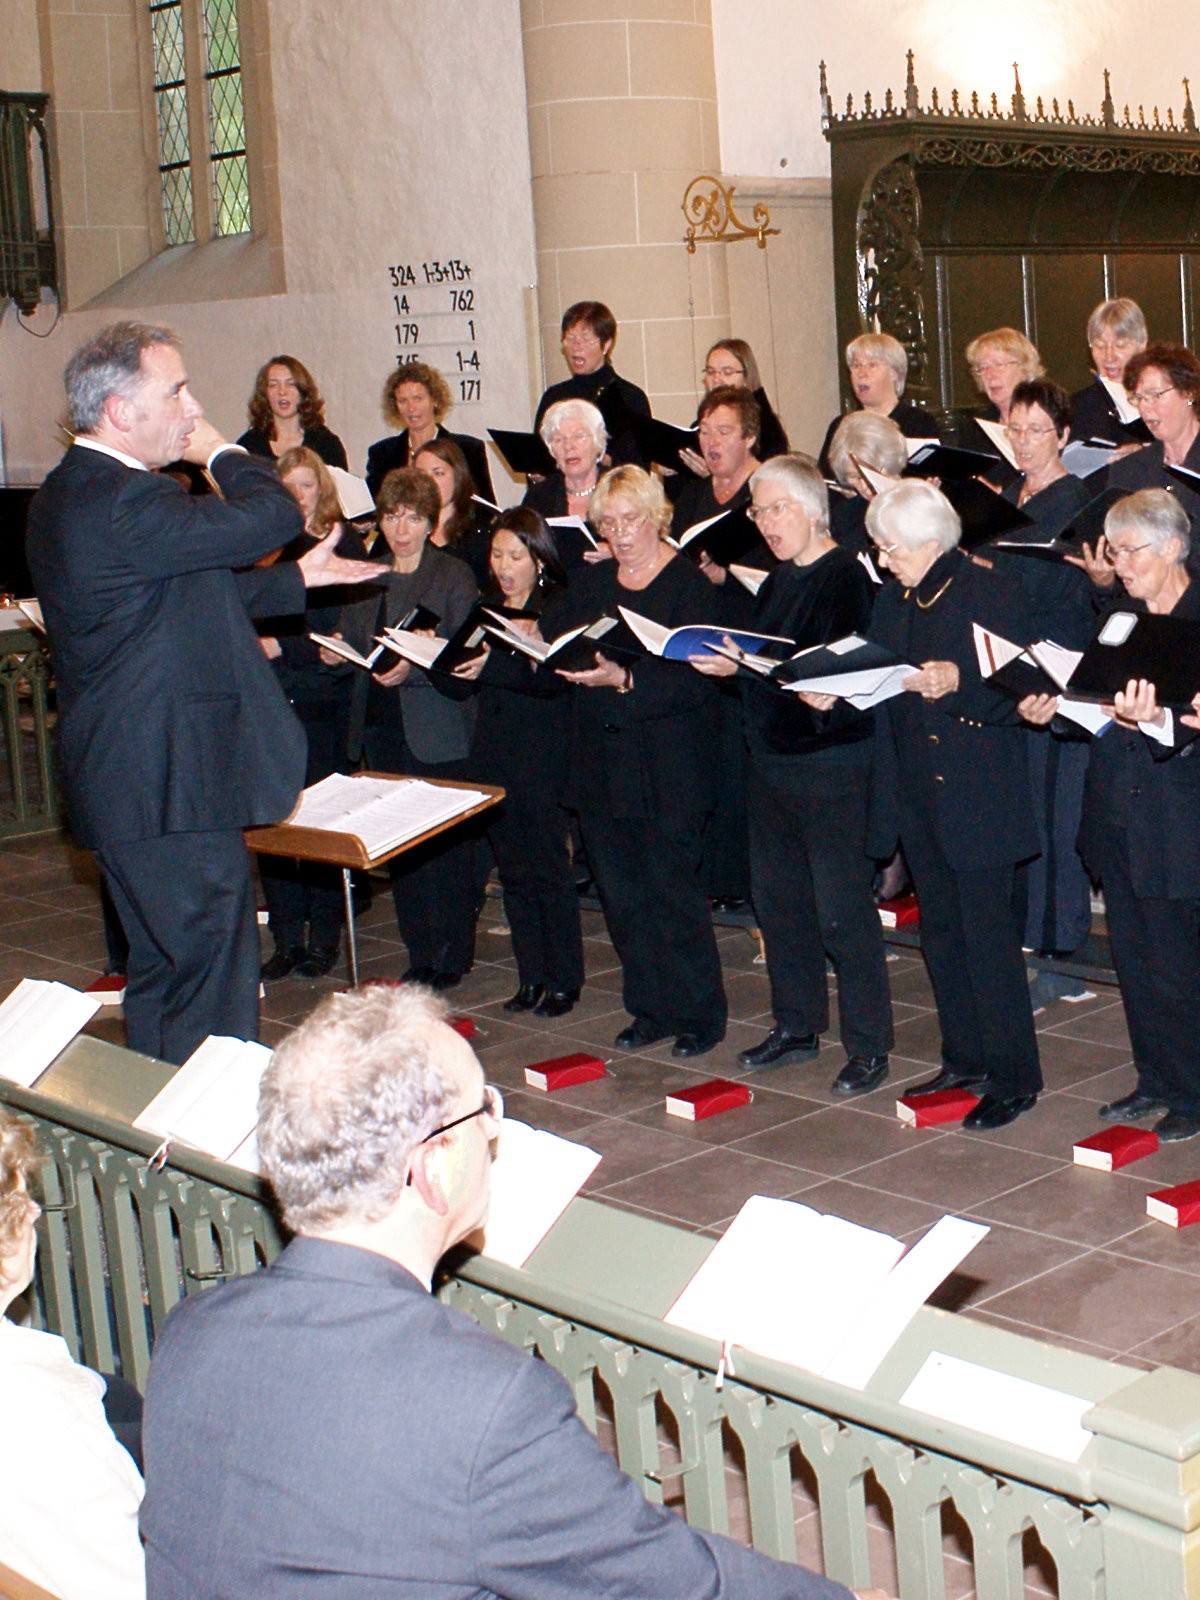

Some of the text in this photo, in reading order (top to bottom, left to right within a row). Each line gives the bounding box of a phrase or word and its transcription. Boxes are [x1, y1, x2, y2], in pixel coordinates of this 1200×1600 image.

[388, 265, 416, 287] 324
[394, 289, 474, 315] 14 762
[395, 320, 475, 344] 179 1
[456, 350, 480, 371] 1-4
[460, 379, 481, 401] 171
